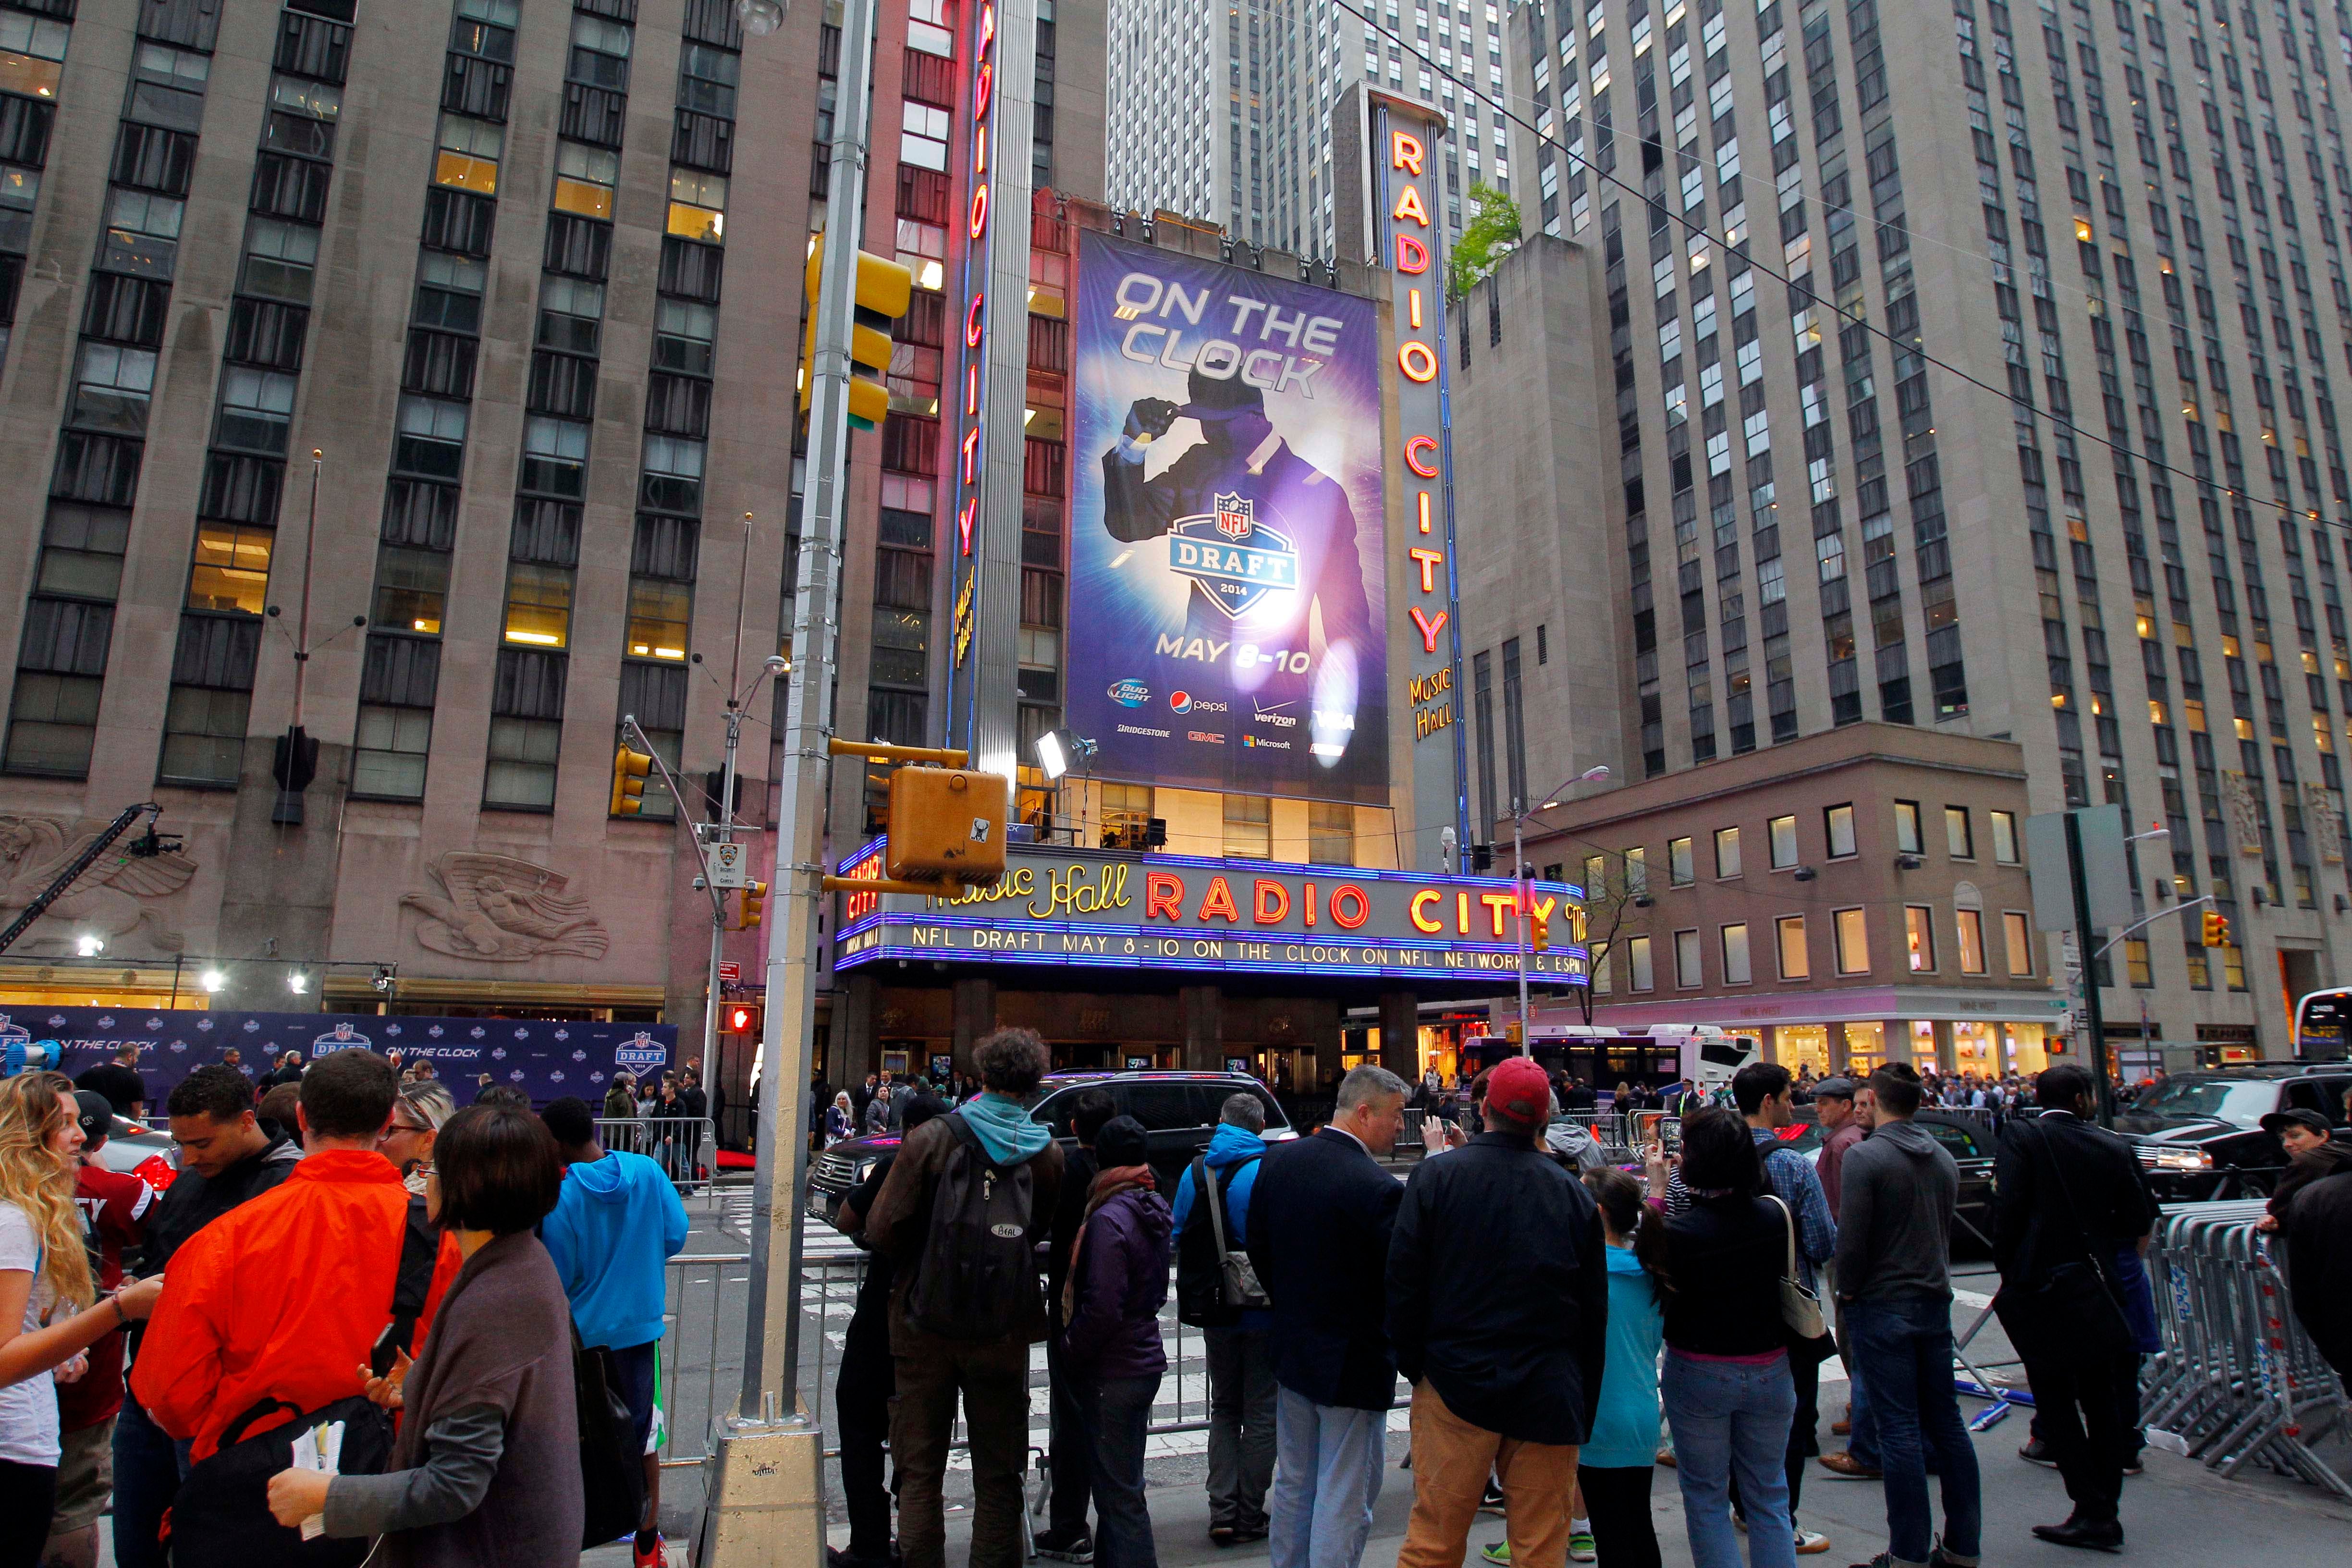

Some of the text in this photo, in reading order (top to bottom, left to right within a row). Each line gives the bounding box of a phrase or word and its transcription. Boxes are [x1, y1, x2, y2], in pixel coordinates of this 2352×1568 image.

[970, 0, 994, 239] ADIO
[1393, 130, 1438, 382] RADIO
[1115, 272, 1344, 356] ON THE
[1121, 324, 1324, 400] CLOCK
[959, 293, 984, 557] CITY
[1219, 512, 1249, 534] NFL
[1405, 435, 1449, 653] CITY
[1178, 543, 1288, 579] DRAFT
[1220, 583, 1248, 596] 2014
[1155, 633, 1311, 674] MAY 8-10
[1115, 690, 1152, 702] LIGHT
[1121, 684, 1149, 694] BUD
[1193, 700, 1227, 712] pepsi
[1254, 713, 1297, 727] verizon
[1117, 724, 1171, 738] BRIDGESTONE
[1188, 731, 1225, 744] GMC
[1256, 738, 1291, 749] Microsoft
[1027, 862, 1131, 919] Hall
[1146, 871, 1370, 929] RADIO
[912, 927, 955, 946] NFL
[973, 930, 1046, 950] DRAFT
[1063, 934, 1107, 953] MAY
[1194, 941, 1222, 958] ON
[1237, 943, 1271, 960] THE
[1286, 945, 1350, 963] CLOCK
[1362, 948, 1388, 965] ON
[1400, 949, 1432, 967] NFL
[1536, 956, 1545, 970] &
[1556, 957, 1580, 973] ESPN
[73, 1040, 106, 1050] THE
[409, 1047, 436, 1056] THE
[437, 1048, 481, 1057] CLOCK
[637, 1039, 648, 1047] NFL
[620, 1052, 662, 1061] DRAFT
